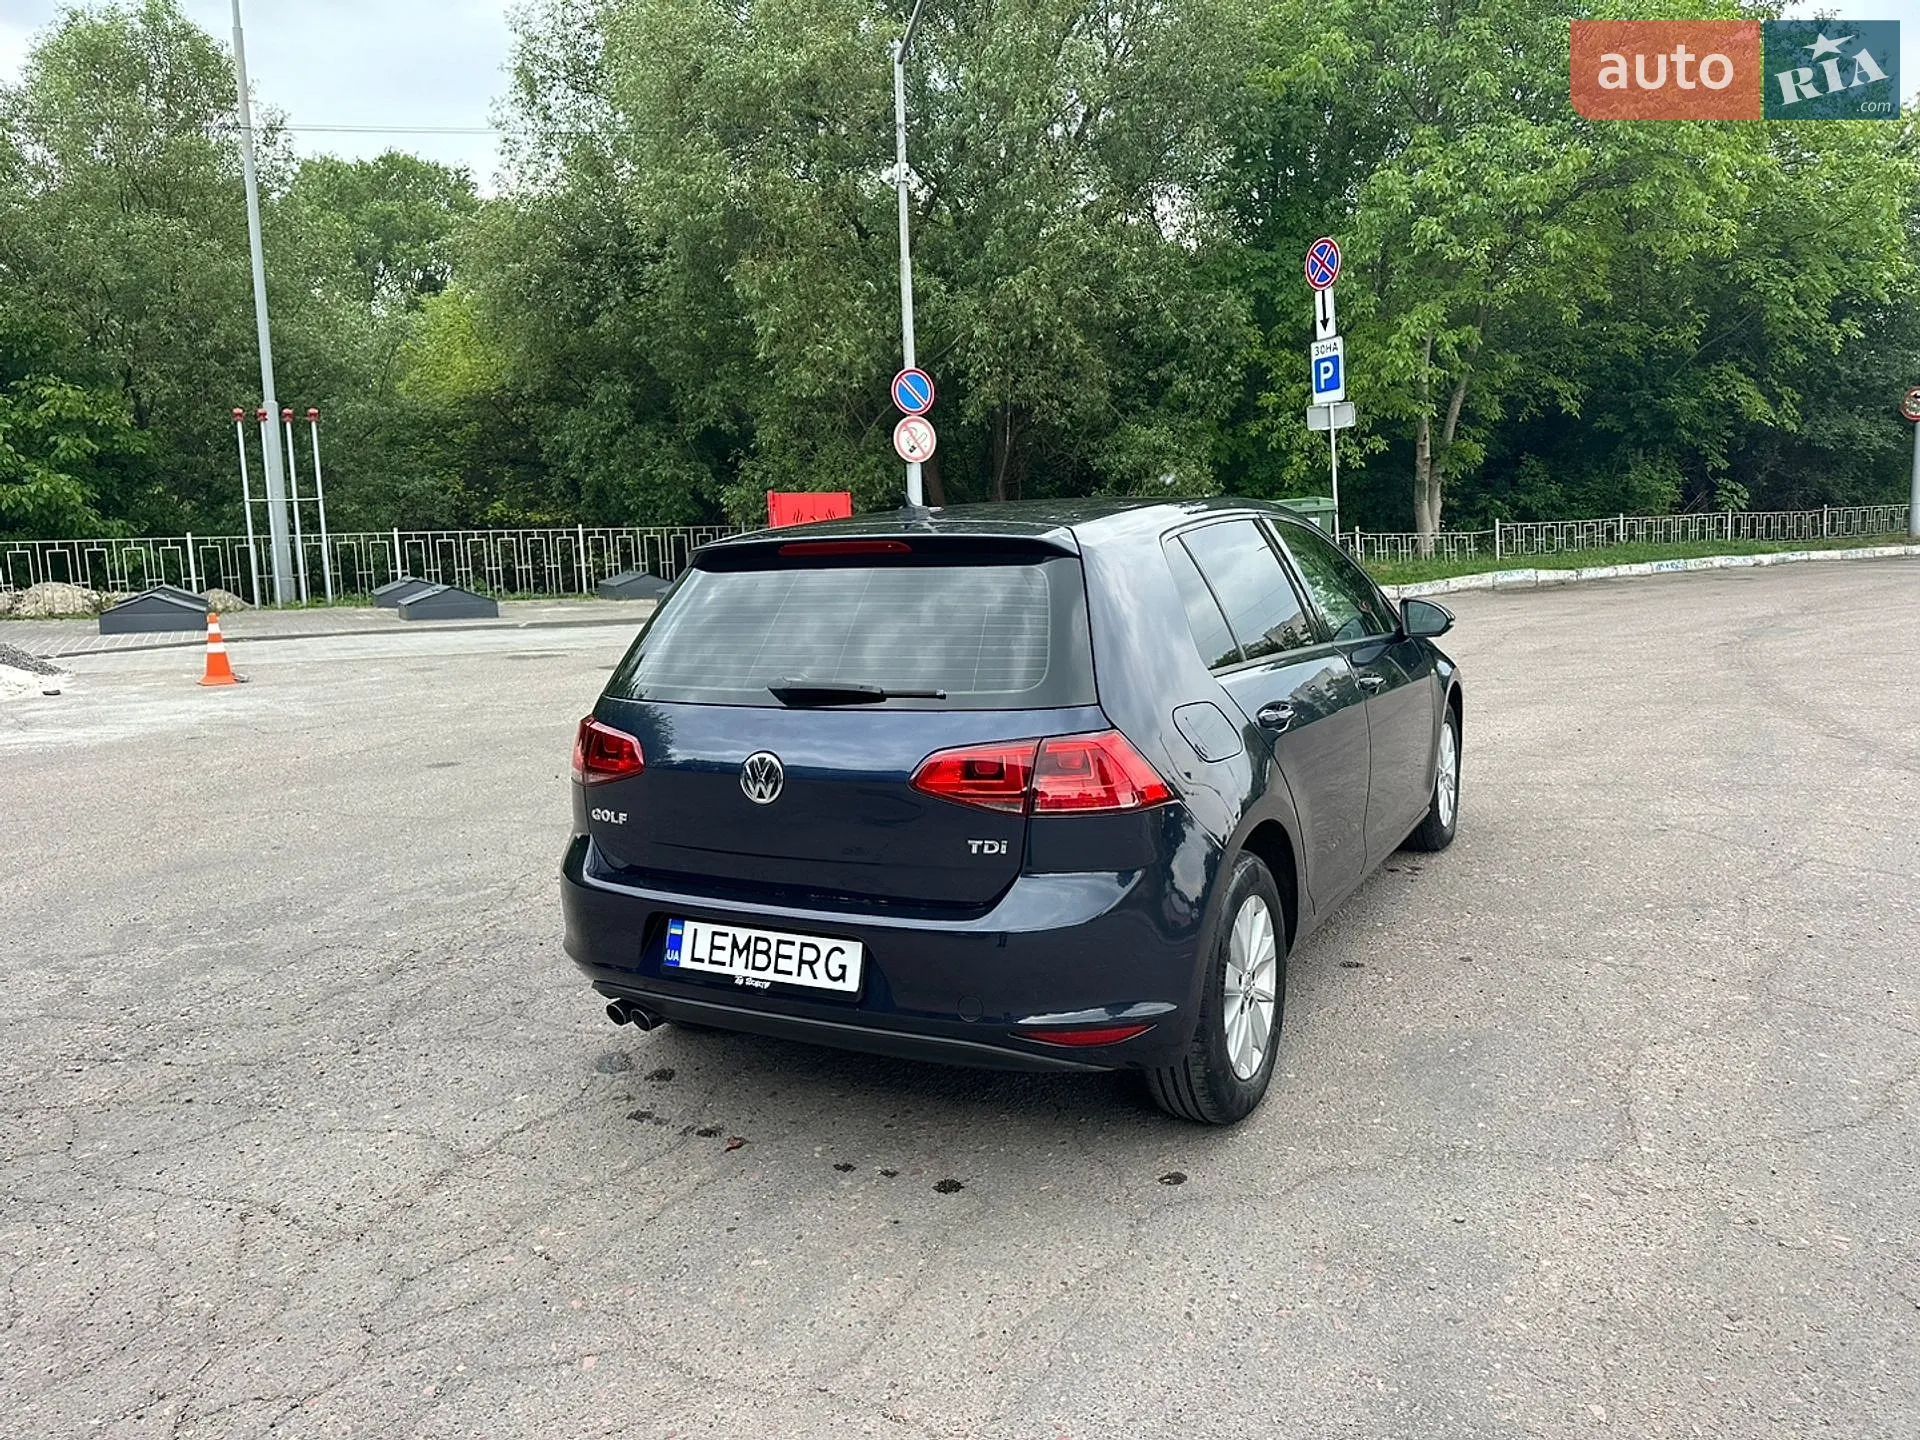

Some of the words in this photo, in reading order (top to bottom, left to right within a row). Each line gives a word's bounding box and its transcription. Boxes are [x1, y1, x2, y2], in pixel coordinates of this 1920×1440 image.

[1314, 342, 1339, 357] ЗОНА
[1320, 361, 1334, 389] P
[591, 808, 628, 825] GOLF
[666, 948, 680, 962] UA
[690, 928, 848, 984] LEMBERG
